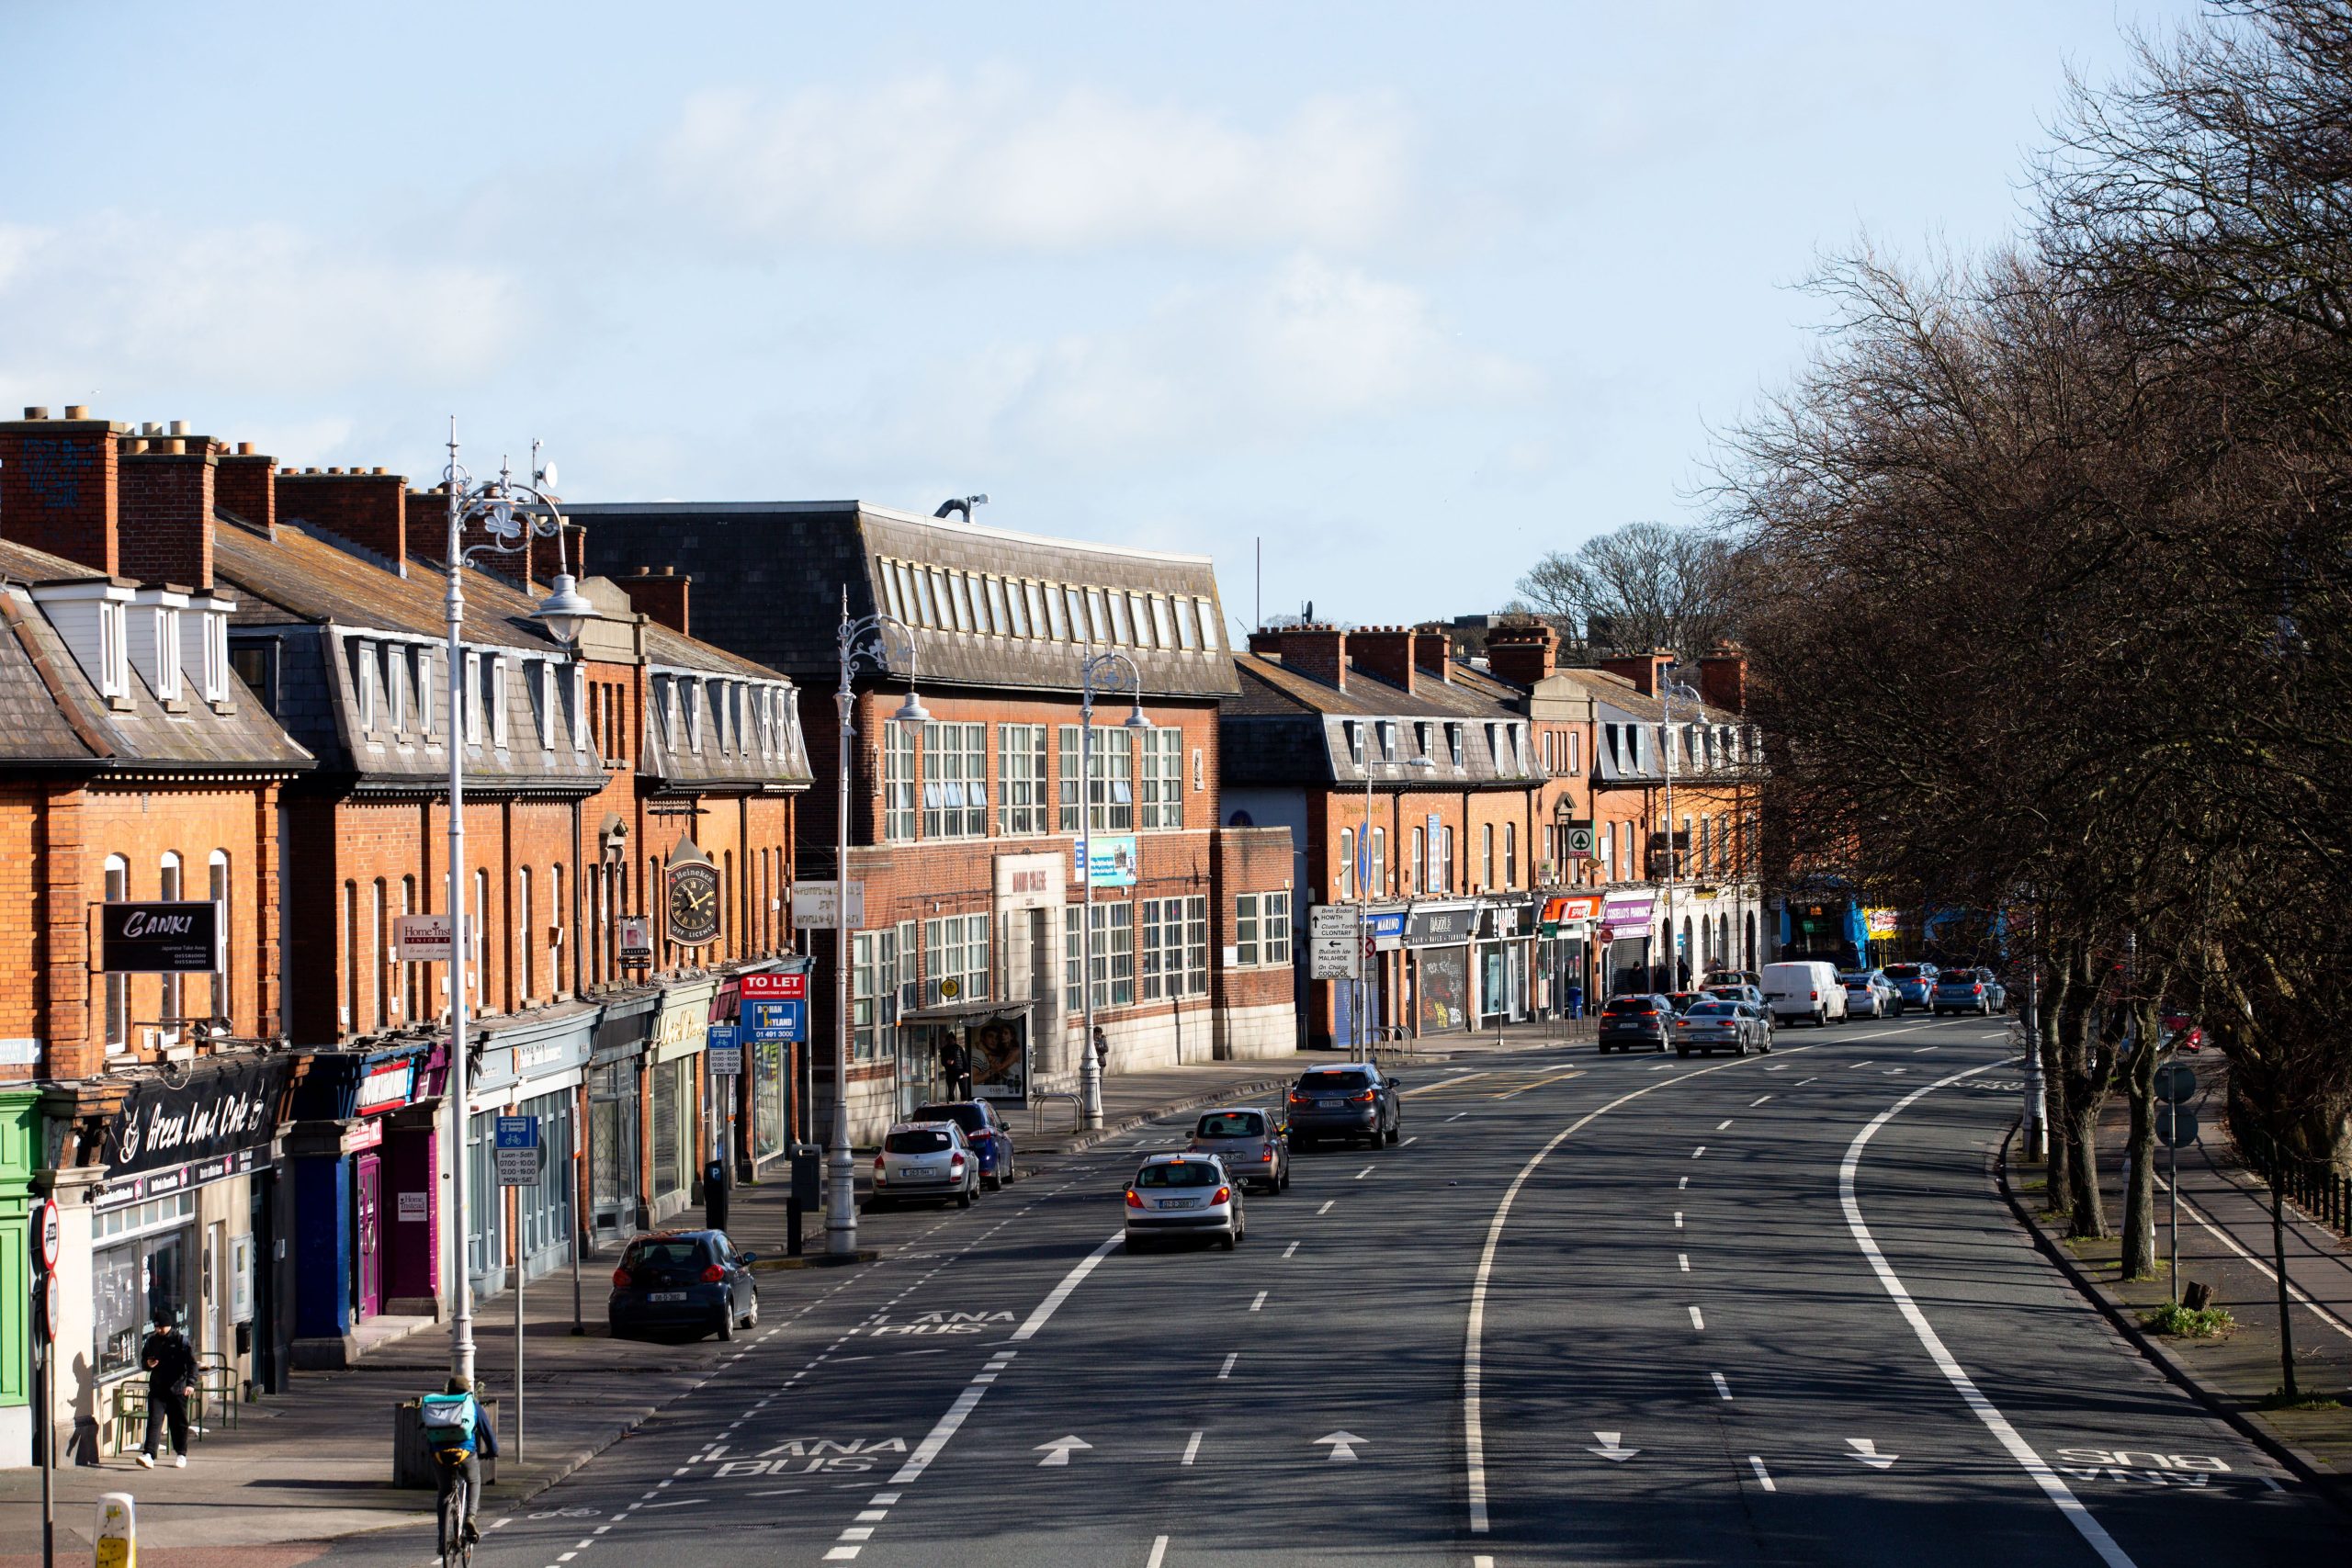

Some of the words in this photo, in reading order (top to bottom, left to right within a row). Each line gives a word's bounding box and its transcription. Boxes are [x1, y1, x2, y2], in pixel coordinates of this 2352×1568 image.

[675, 868, 715, 884] Heineken
[1570, 908, 1587, 918] SPAR
[1630, 906, 1651, 918] PHARMACY
[122, 910, 193, 937] GANKI
[672, 925, 685, 935] OFF
[688, 923, 717, 937] LICENCE
[1377, 918, 1400, 931] MARINO
[1429, 916, 1452, 933] DAZZLE
[404, 926, 432, 936] Home
[746, 976, 768, 987] TO
[773, 976, 800, 987] LET
[757, 1005, 783, 1014] BOHAN
[146, 1102, 185, 1152] Green
[869, 1323, 989, 1337] BUS
[712, 1456, 878, 1478] BUS
